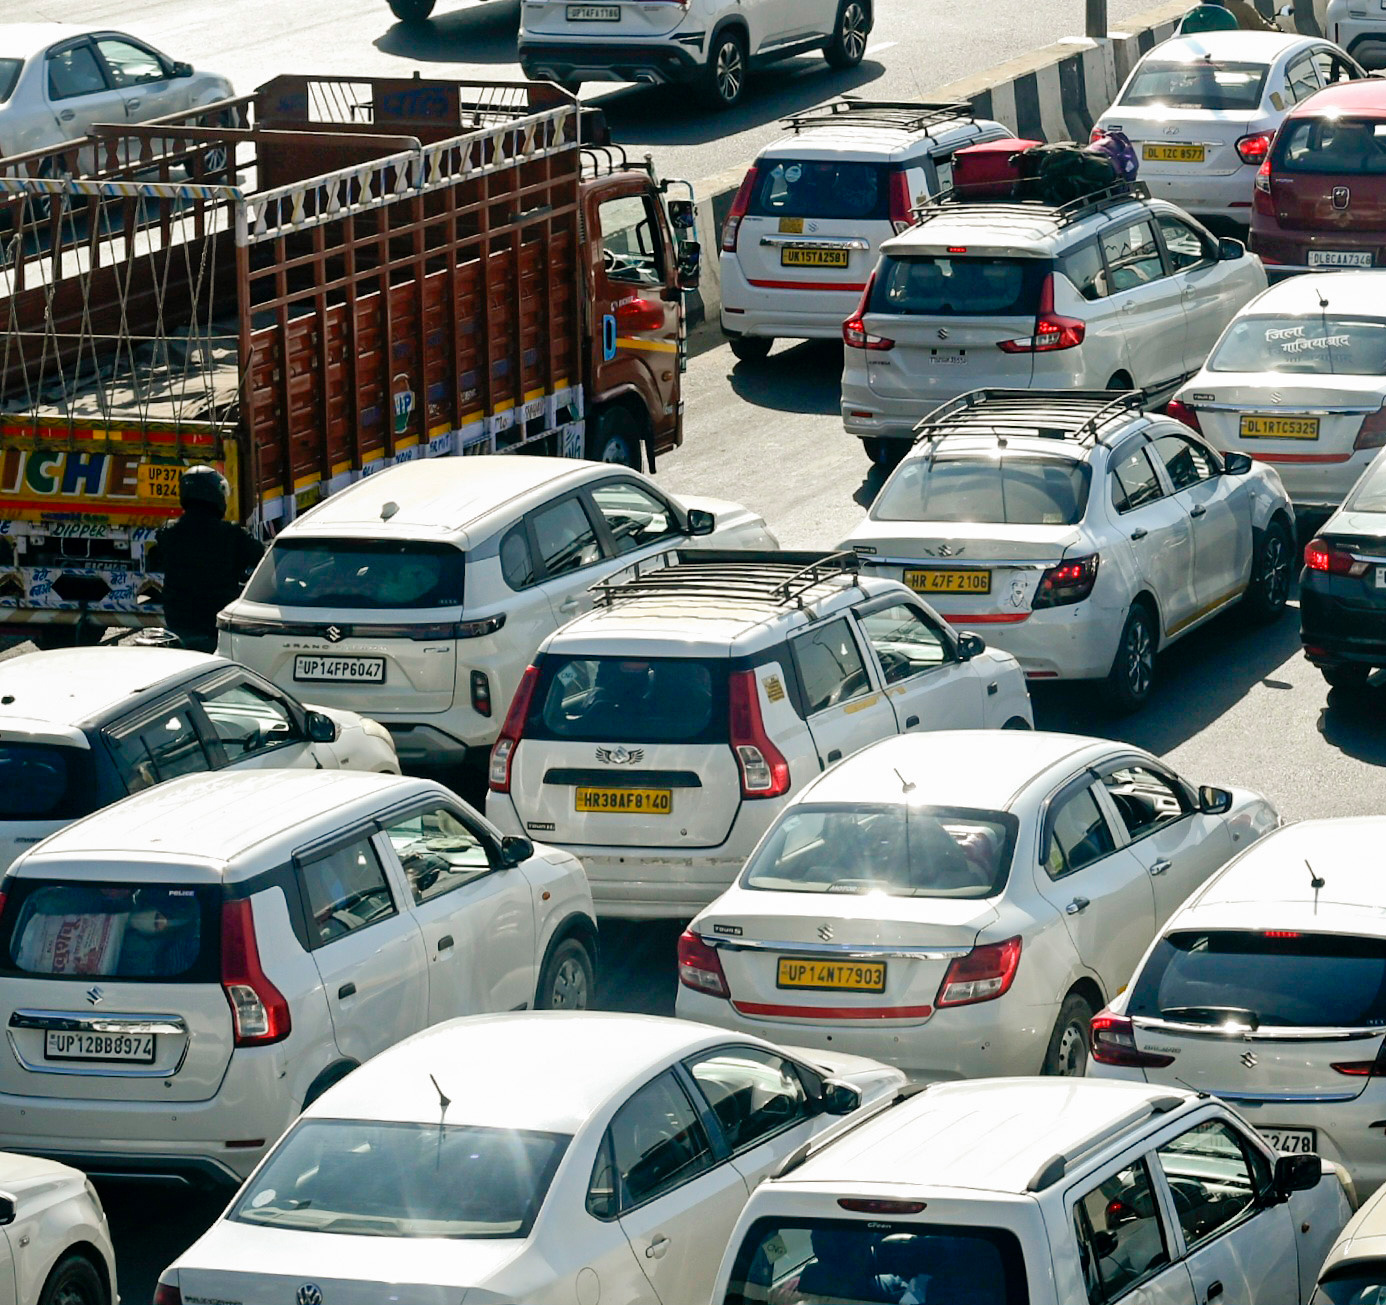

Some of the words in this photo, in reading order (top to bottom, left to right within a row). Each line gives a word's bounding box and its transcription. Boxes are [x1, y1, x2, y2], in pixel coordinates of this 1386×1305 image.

[1148, 148, 1159, 158] DL
[1265, 327, 1306, 343] जिला
[1248, 419, 1316, 434] DL1RTC5325
[0, 452, 184, 497] ICHE
[54, 523, 107, 538] DIPPER
[912, 575, 926, 588] HR
[932, 575, 953, 588] 47F
[958, 575, 987, 588] 2106
[303, 659, 382, 679] UP14FP6047
[584, 792, 669, 810] HR38AF8140
[788, 962, 883, 987] UP14NT7903
[56, 1035, 152, 1057] UP12BB8974
[1264, 1132, 1312, 1155] 2478
